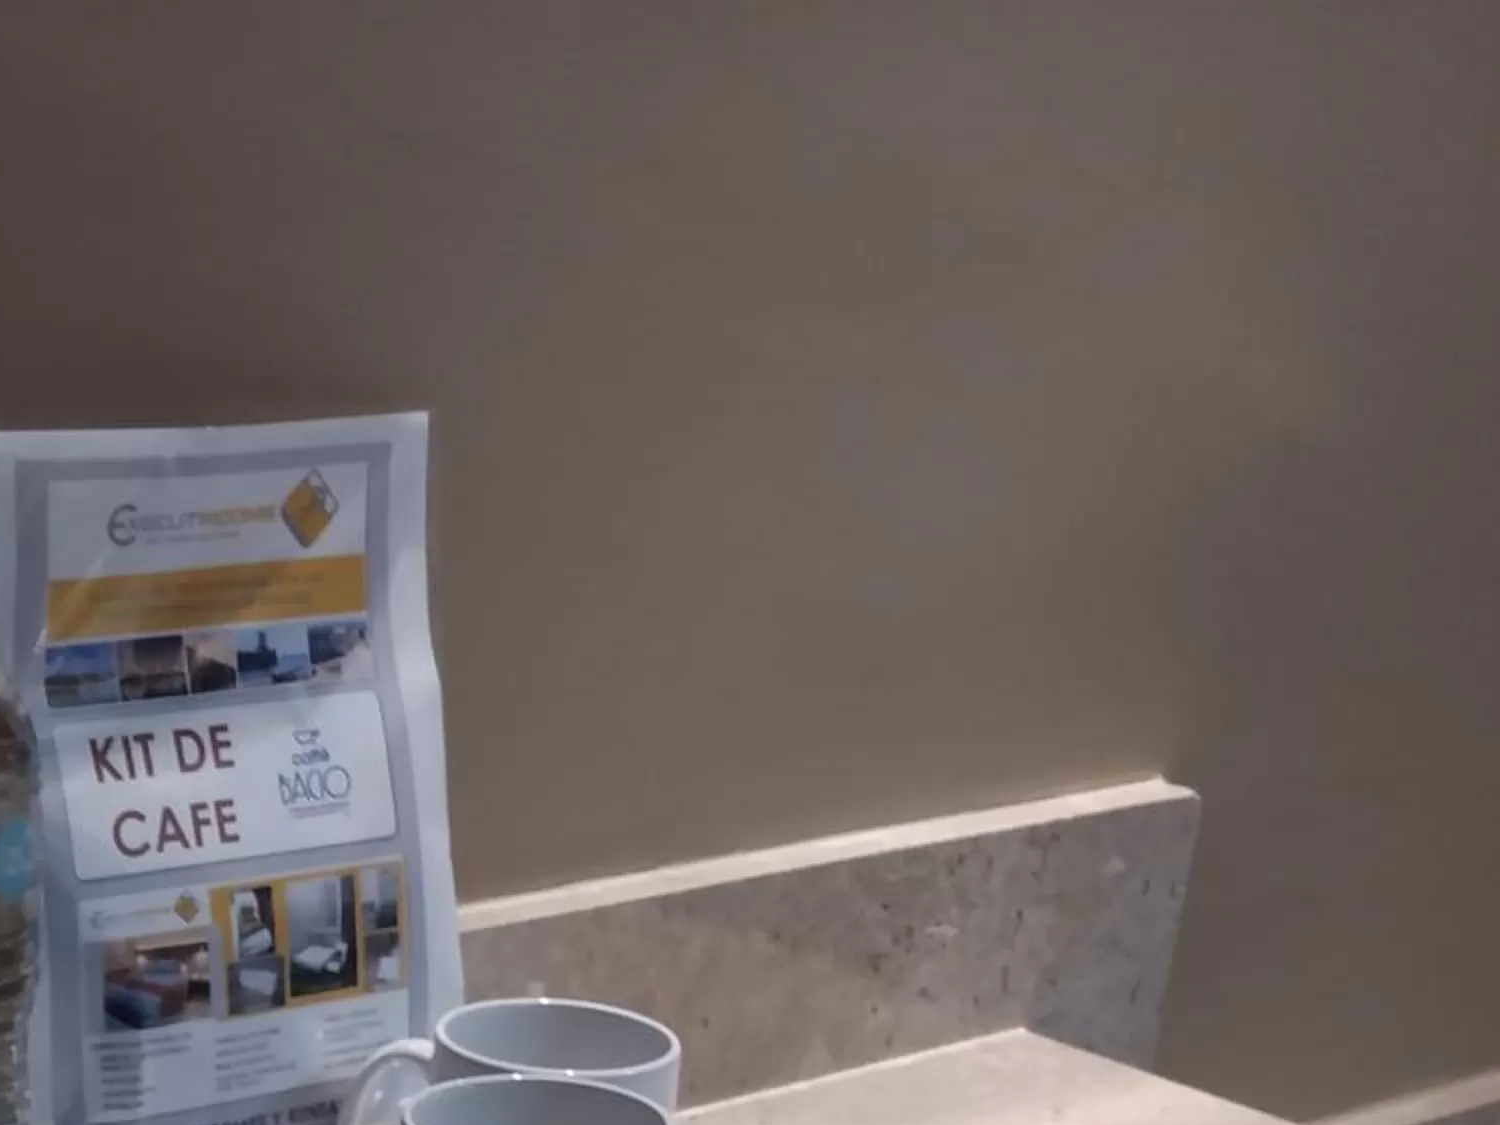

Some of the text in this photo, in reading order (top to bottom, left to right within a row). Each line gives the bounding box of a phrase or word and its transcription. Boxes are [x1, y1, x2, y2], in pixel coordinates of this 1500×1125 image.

[88, 723, 237, 784] KIT DE
[112, 799, 241, 858] CAFE
